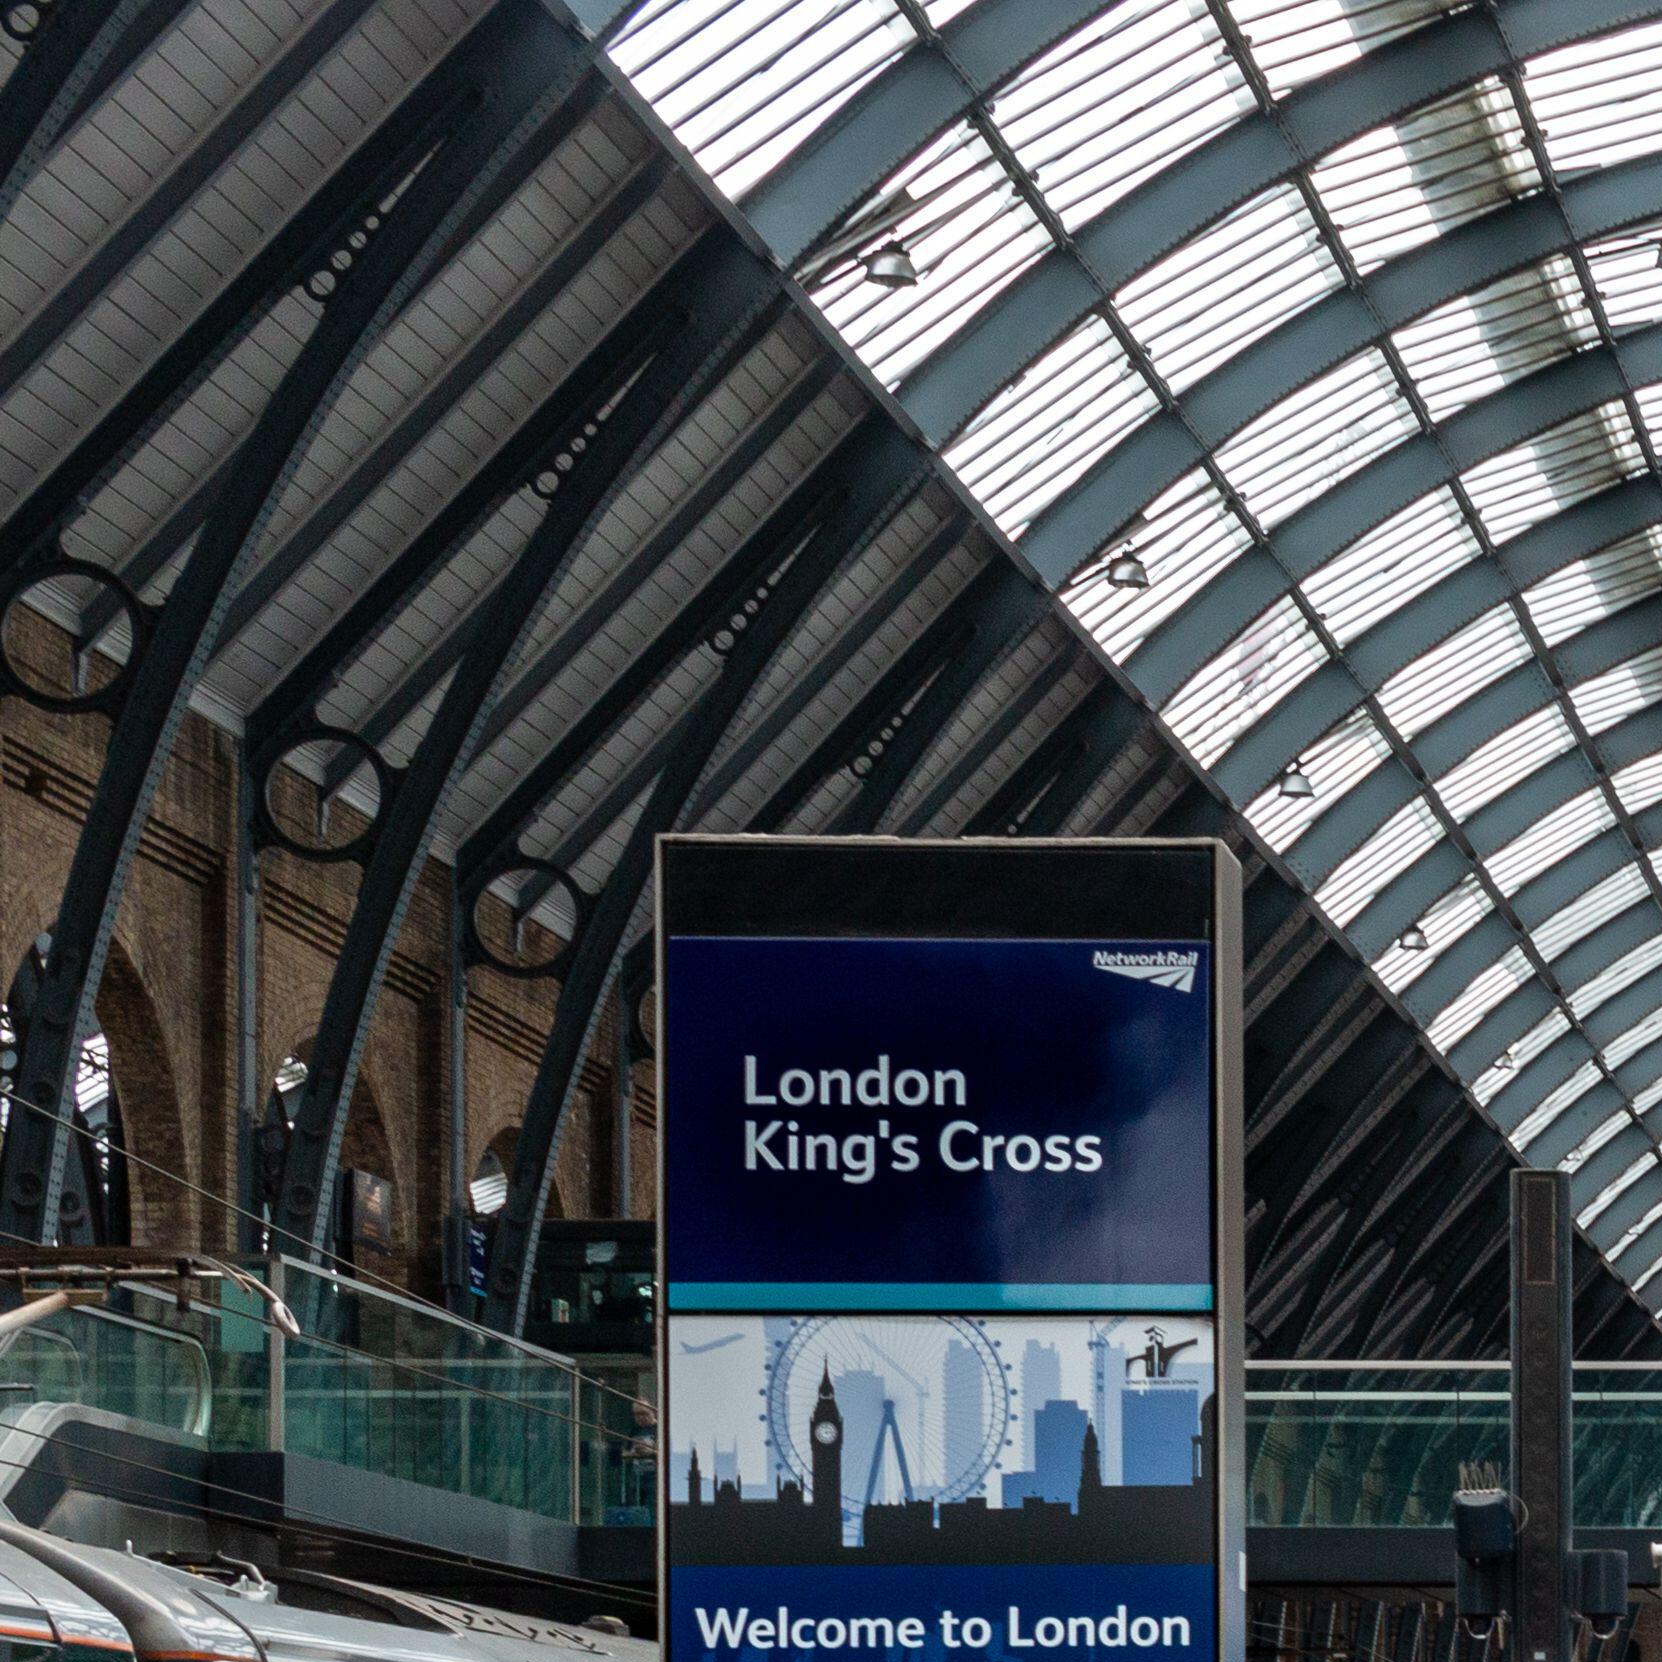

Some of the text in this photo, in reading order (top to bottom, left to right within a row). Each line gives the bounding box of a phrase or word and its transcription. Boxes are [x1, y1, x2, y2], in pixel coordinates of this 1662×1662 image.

[744, 1054, 967, 1106] London
[744, 1119, 1103, 1184] King's Cross
[694, 1604, 1191, 1649] Welcome to London
